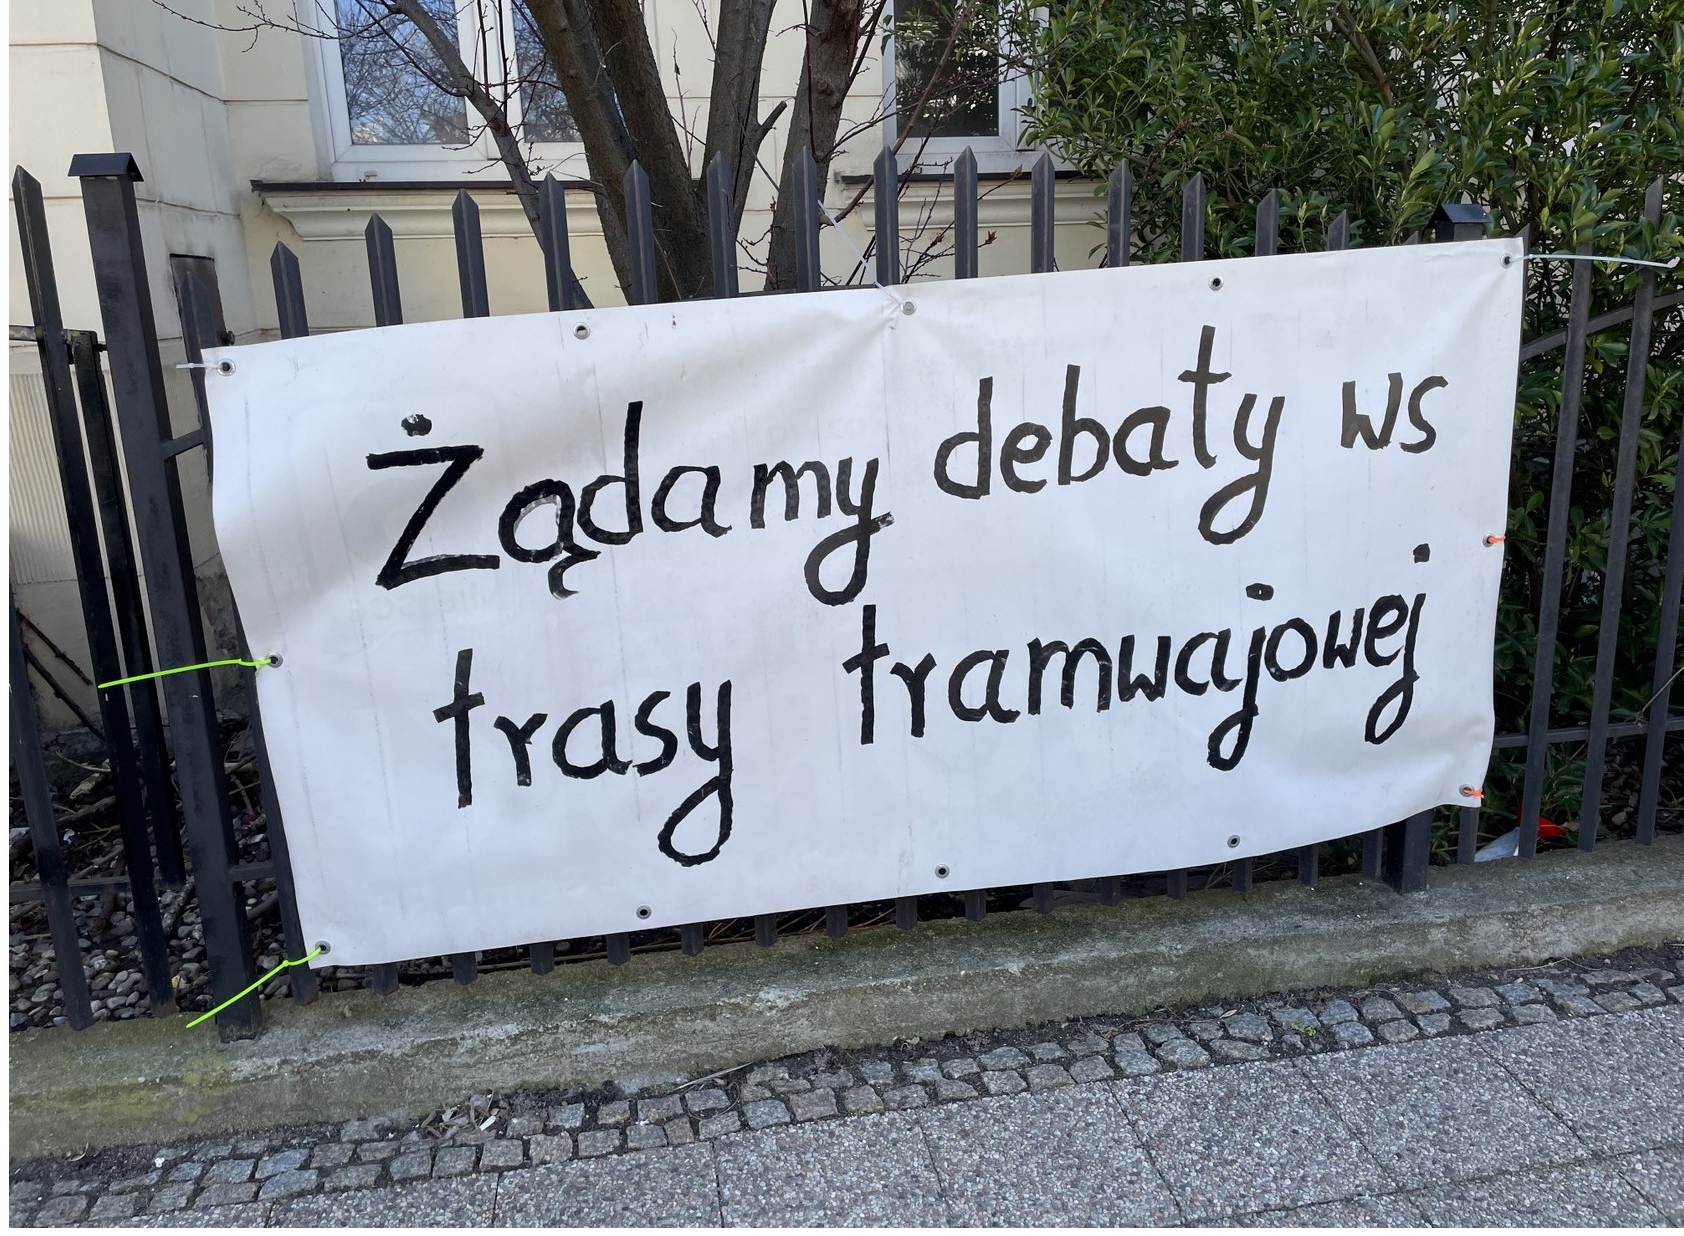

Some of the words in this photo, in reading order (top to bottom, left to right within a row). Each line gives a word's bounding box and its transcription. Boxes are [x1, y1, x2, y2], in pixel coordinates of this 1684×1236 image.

[366, 400, 893, 606] Żądamy
[934, 325, 1285, 546] debaty
[1341, 372, 1449, 454] ws
[433, 647, 733, 867] trasy
[843, 543, 1432, 771] tramwajowej
